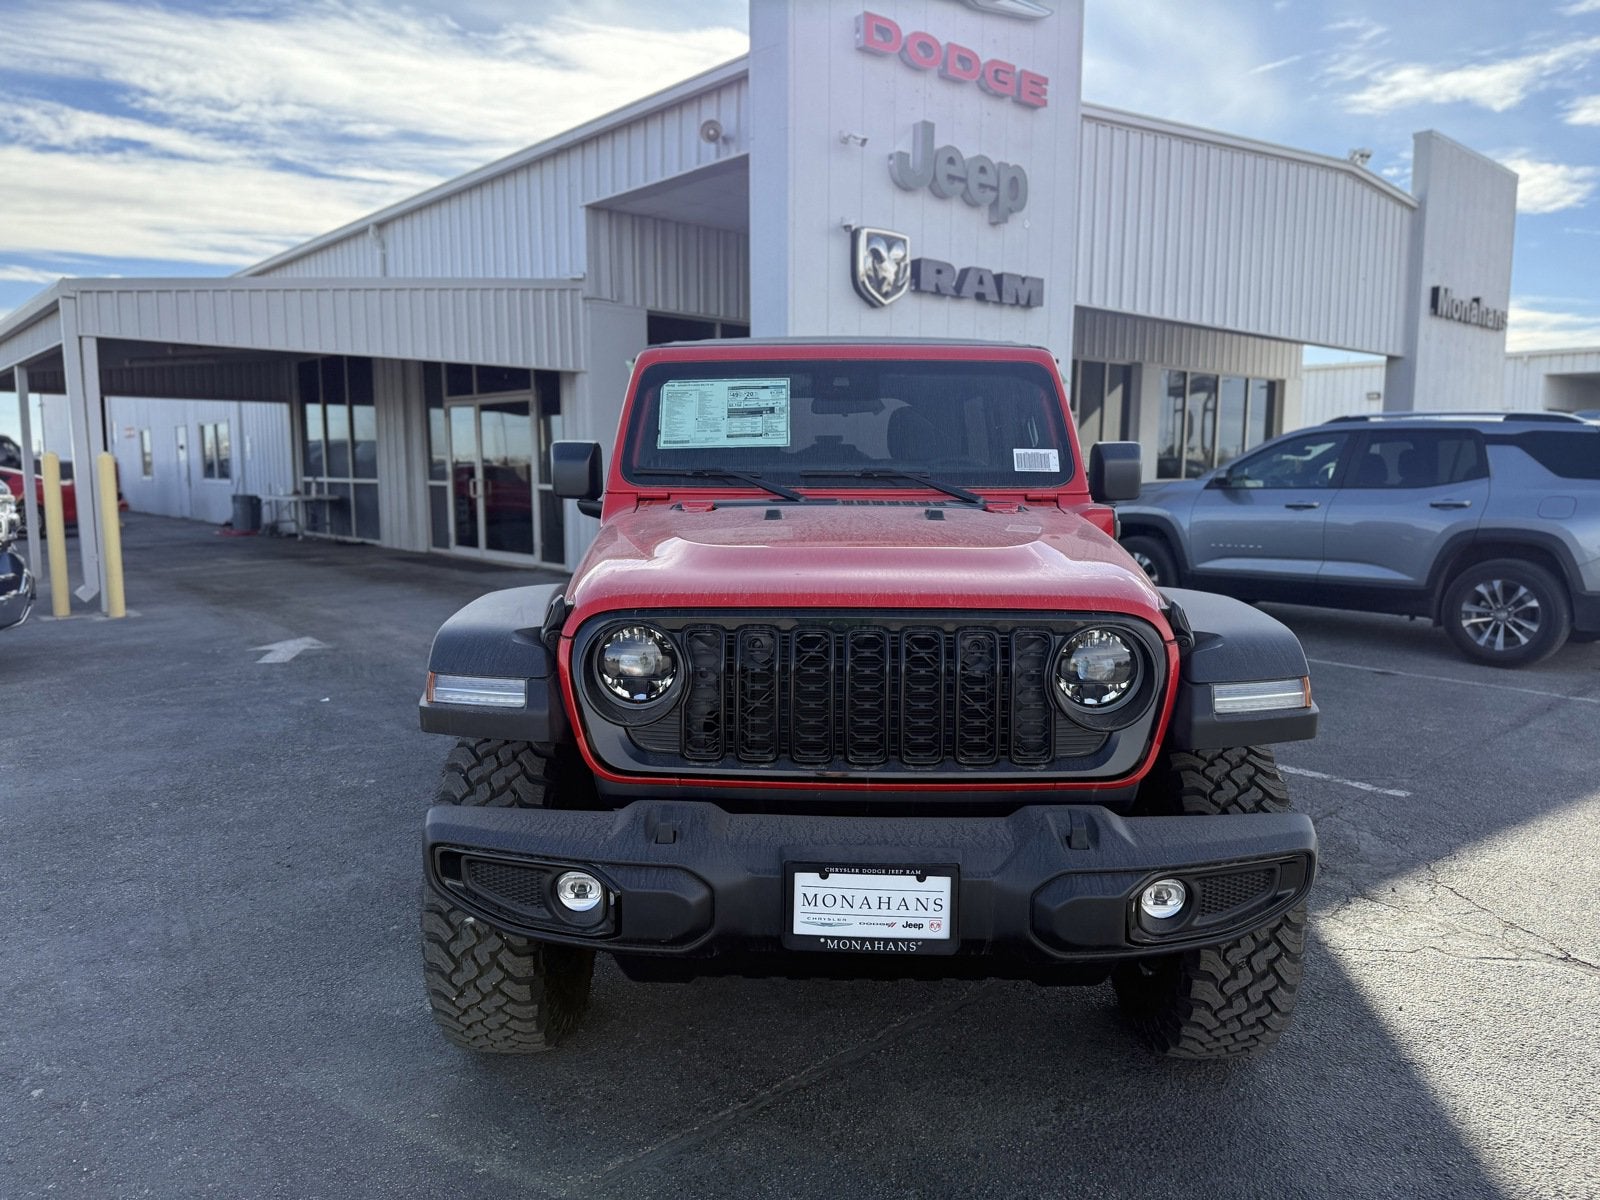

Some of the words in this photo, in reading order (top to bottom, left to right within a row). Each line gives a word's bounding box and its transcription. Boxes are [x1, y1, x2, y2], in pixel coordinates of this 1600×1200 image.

[856, 11, 1048, 109] DODGE
[888, 120, 1028, 225] Jeep
[911, 257, 1044, 308] RAM
[1430, 286, 1509, 332] Monahans
[801, 892, 944, 913] MONAHANS
[902, 920, 924, 930] Jeep
[826, 938, 918, 952] MONAHANS
